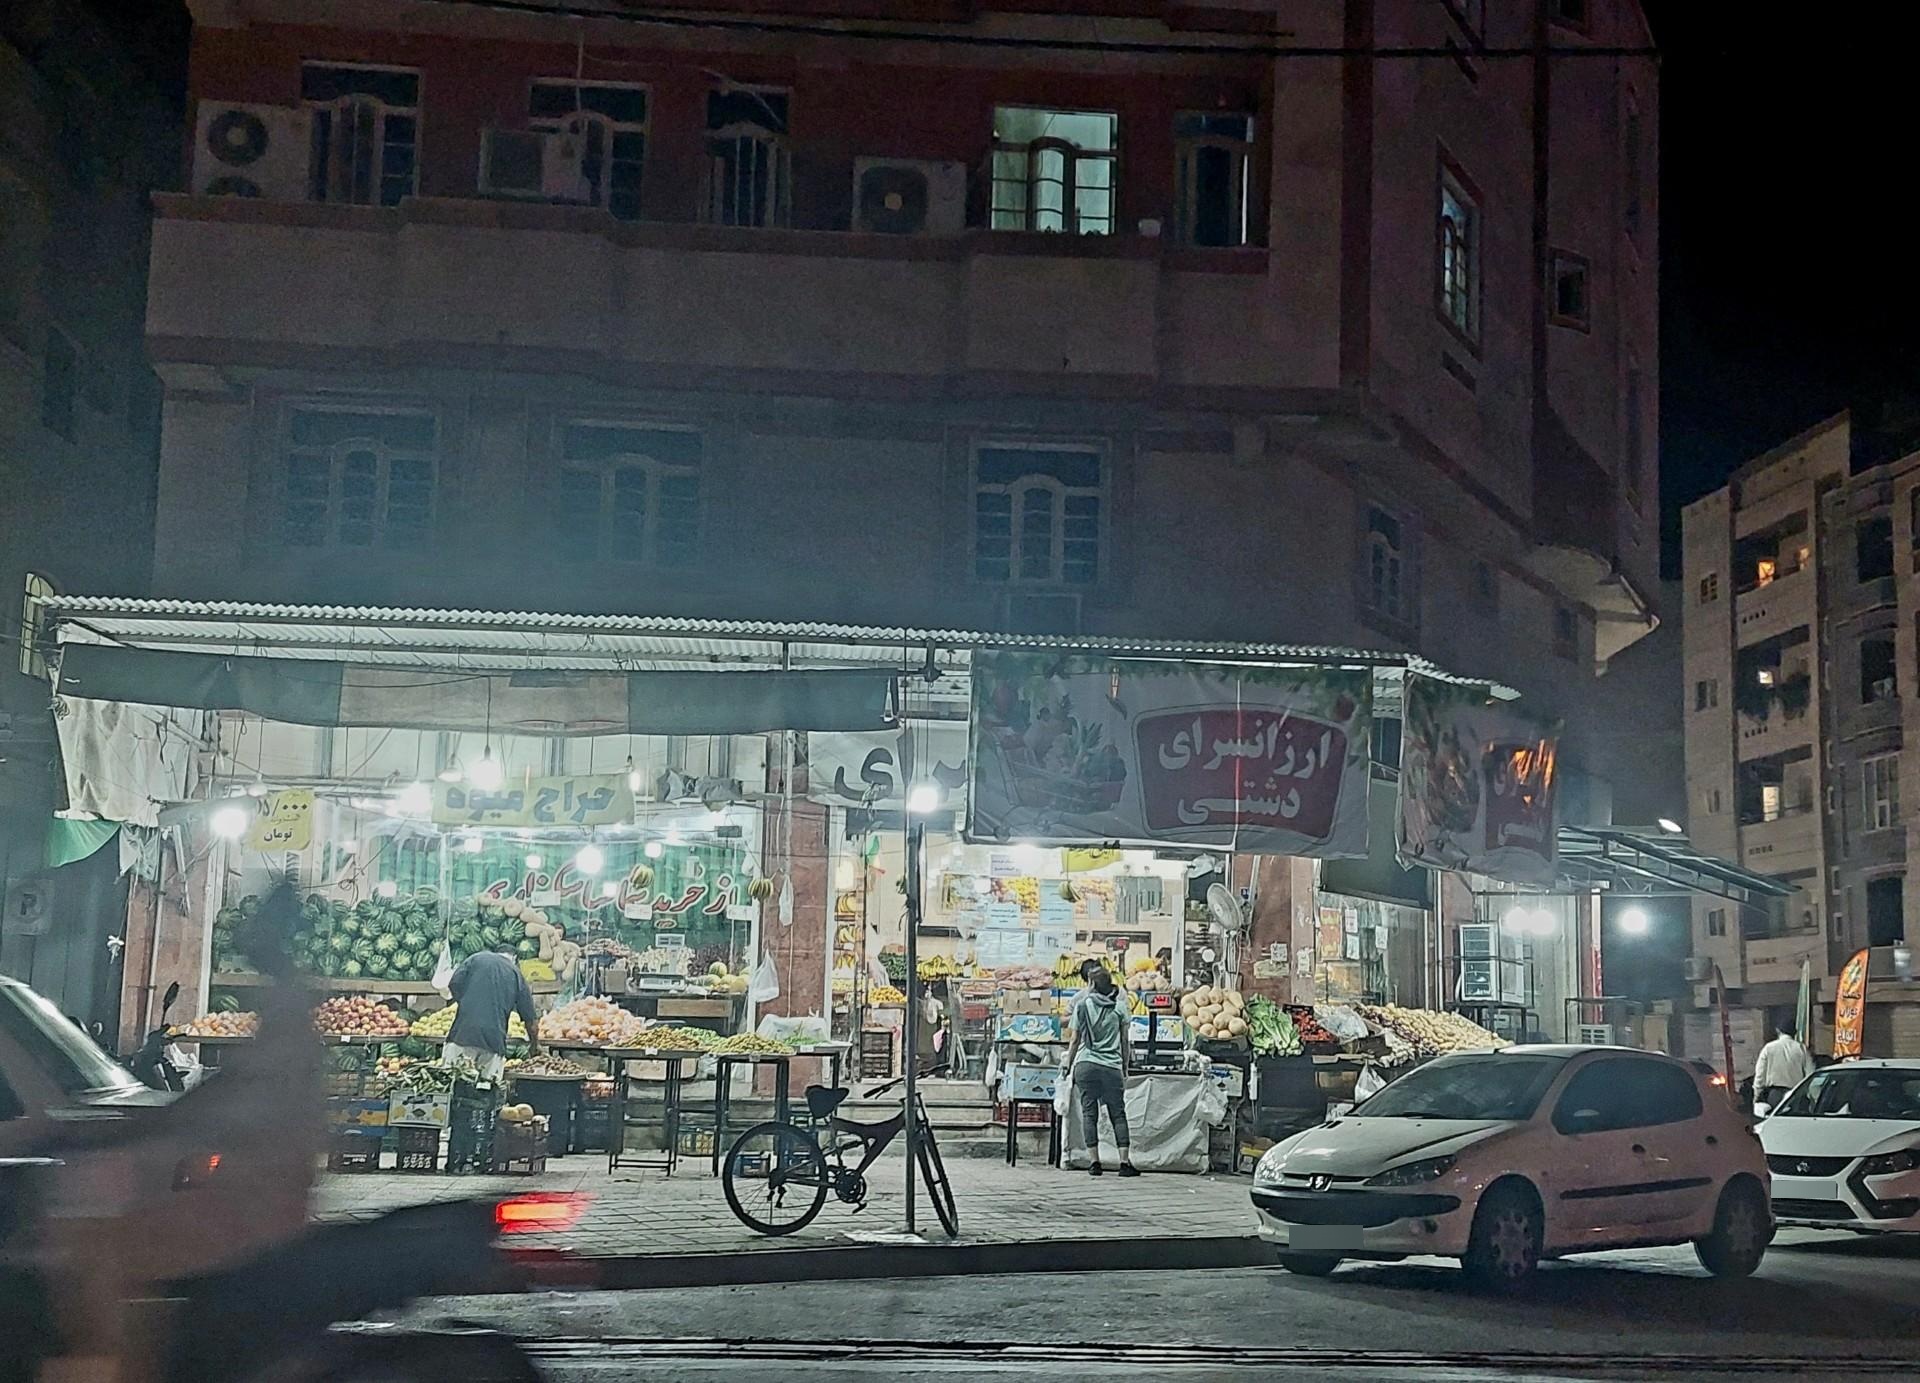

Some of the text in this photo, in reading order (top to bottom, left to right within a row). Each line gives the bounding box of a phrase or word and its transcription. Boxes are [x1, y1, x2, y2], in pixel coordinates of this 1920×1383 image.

[446, 779, 616, 823] حراج میوه
[1177, 777, 1300, 824] دشتی
[263, 827, 293, 842] تومان
